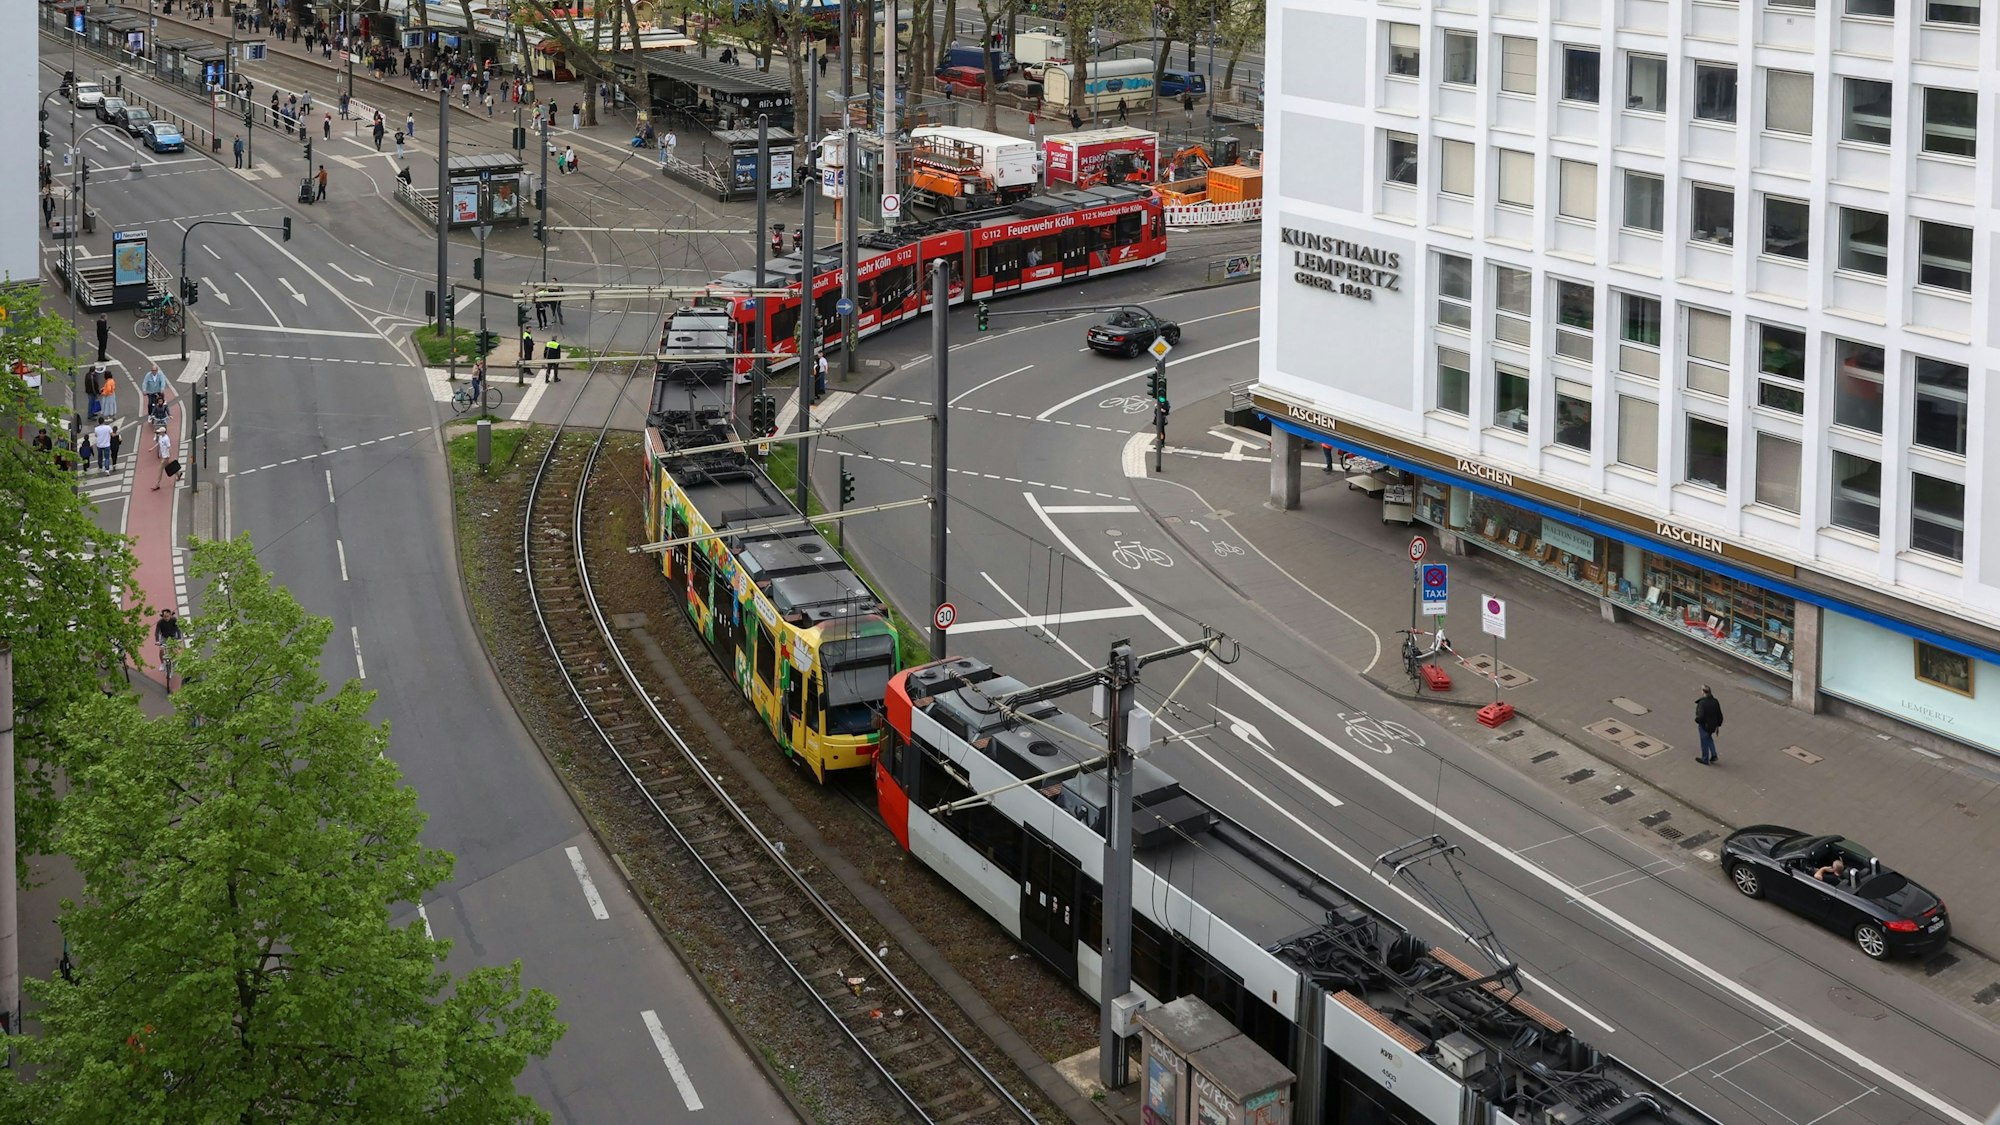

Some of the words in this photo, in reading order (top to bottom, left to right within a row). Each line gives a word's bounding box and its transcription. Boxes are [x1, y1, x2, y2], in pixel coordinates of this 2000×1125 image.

[482, 171, 489, 179] U
[1082, 213, 1092, 221] 112
[1098, 208, 1121, 218] Herzblut
[1130, 203, 1143, 213] Köln
[114, 232, 122, 240] U
[989, 229, 1001, 239] 112
[1007, 219, 1054, 236] Feuerwehr
[1055, 215, 1075, 228] Köln
[902, 249, 912, 260] 112
[1281, 226, 1400, 269] KUNSTHAUS
[874, 255, 891, 270] Köln
[1294, 250, 1399, 292] LEMPERTZ
[1294, 271, 1336, 293] GEGR.
[1339, 282, 1372, 301] 1845
[1286, 404, 1336, 430] TASCHEN
[1455, 458, 1513, 487] TASCHEN
[1653, 520, 1722, 554] TASCHEN
[1412, 543, 1423, 556] 30
[1424, 589, 1446, 598] TAXI
[939, 610, 952, 623] 30
[1901, 699, 1955, 725] LEMPERTZ
